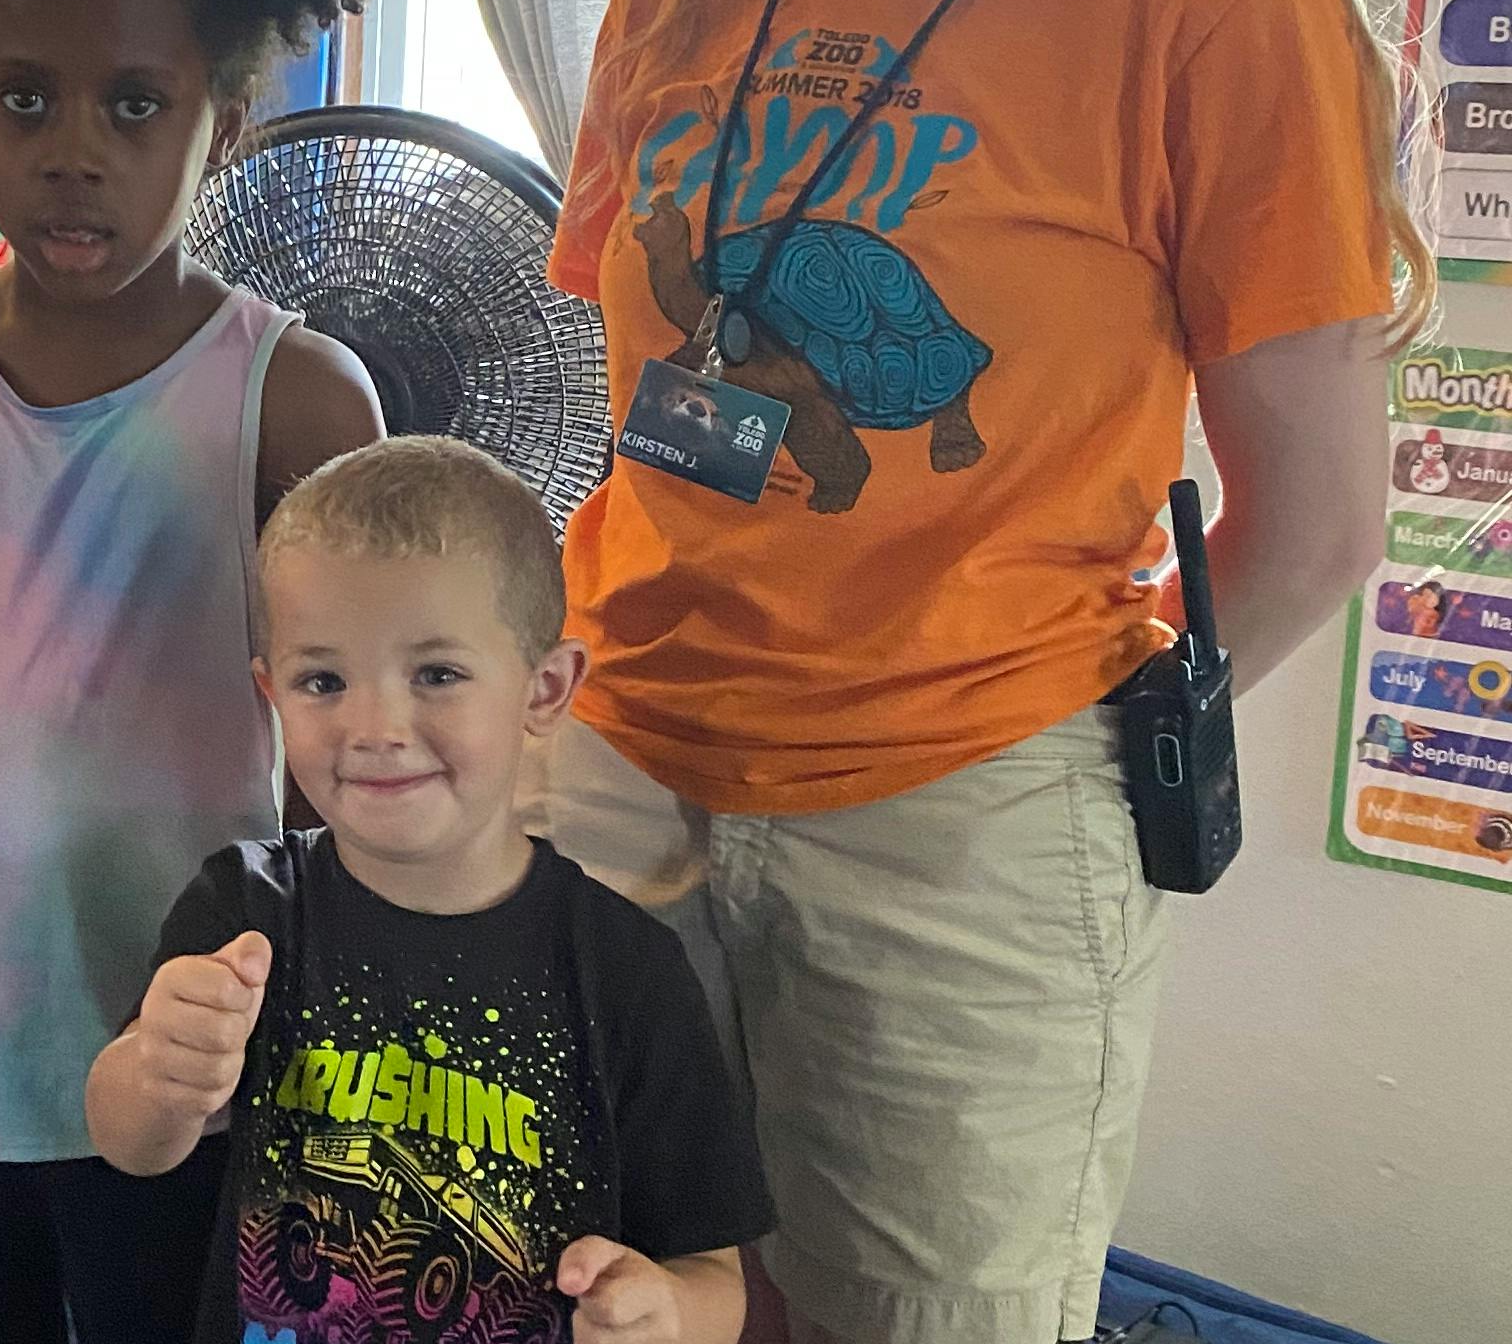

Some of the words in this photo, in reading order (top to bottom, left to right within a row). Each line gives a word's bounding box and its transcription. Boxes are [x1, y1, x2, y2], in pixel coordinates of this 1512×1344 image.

[817, 28, 872, 44] TOLEDO
[1489, 15, 1512, 43] B
[805, 41, 865, 65] ZOO
[852, 81, 924, 110] 218
[621, 430, 686, 466] KIRSTEN
[732, 432, 765, 453] ZOO
[1456, 461, 1512, 485] Janu
[1394, 525, 1460, 550] March
[1480, 609, 1512, 634] Ma
[1382, 667, 1427, 693] July
[1412, 740, 1512, 777] Septembe
[1366, 801, 1469, 837] November
